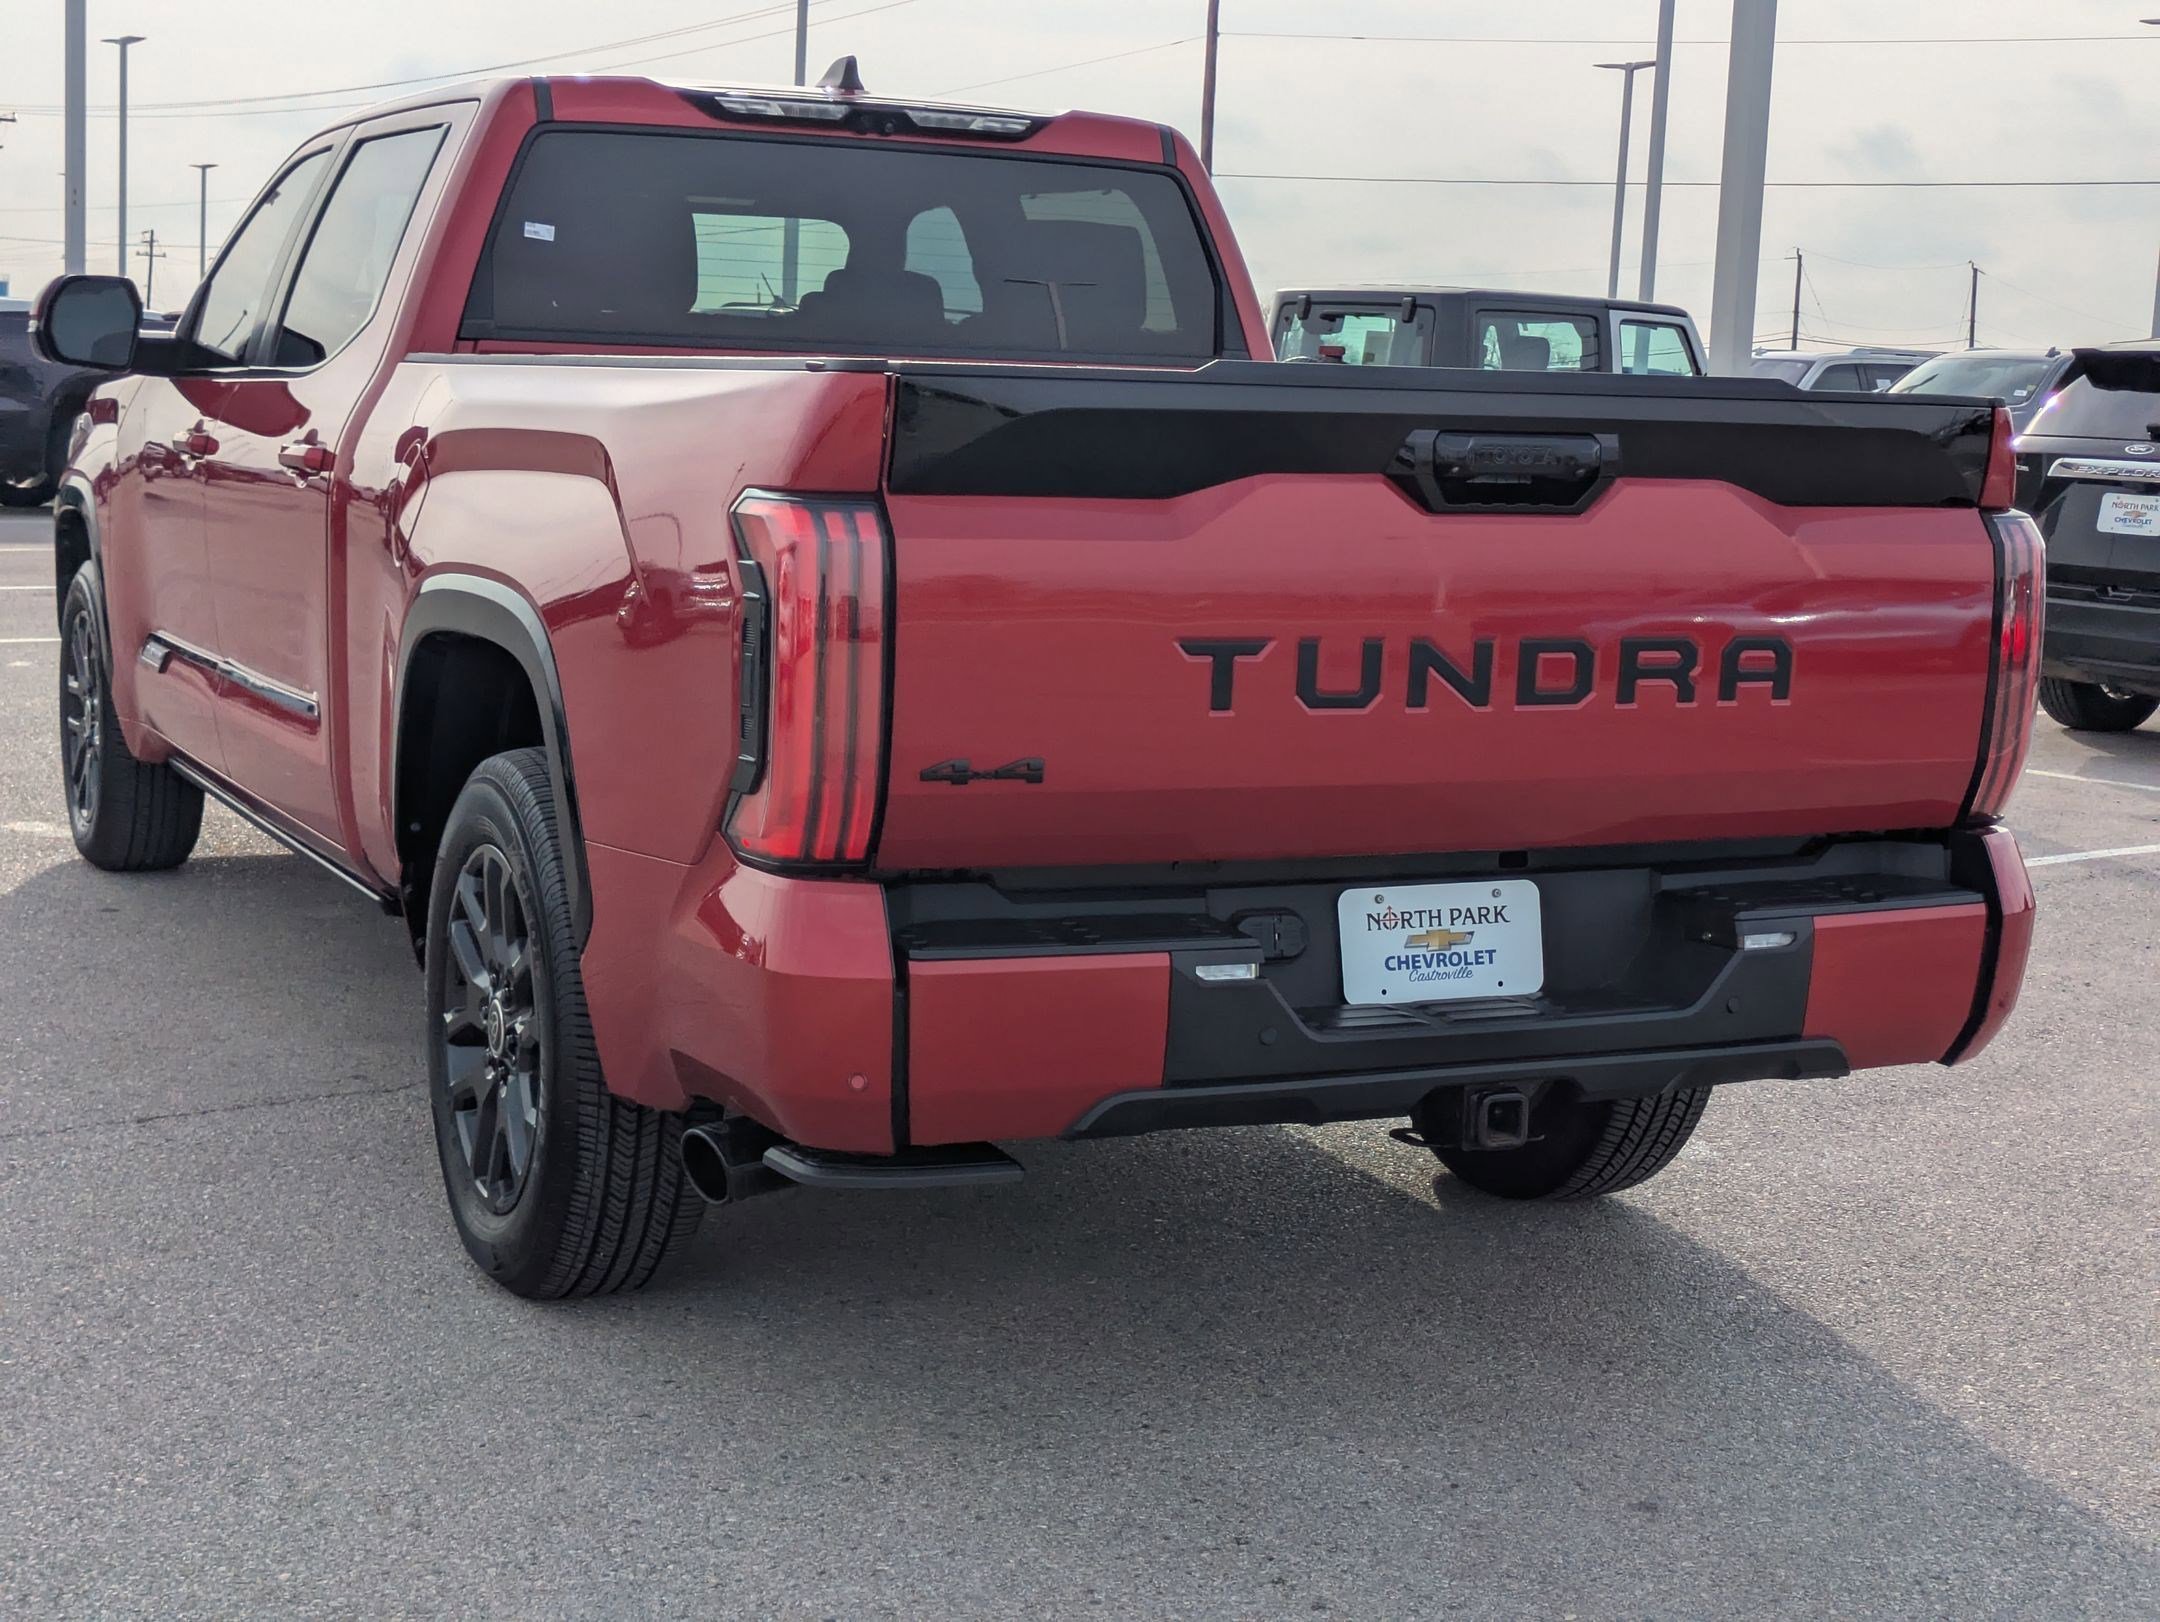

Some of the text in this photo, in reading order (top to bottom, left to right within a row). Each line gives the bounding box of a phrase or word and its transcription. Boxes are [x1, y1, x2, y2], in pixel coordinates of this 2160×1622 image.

[1481, 446, 1558, 465] TOYOTA
[2112, 501, 2160, 511] NORTH PARK
[2114, 517, 2153, 525] CHEVROLET
[1175, 635, 1794, 717] TUNDRA
[1366, 905, 1511, 931] NORTH PARK
[1384, 949, 1497, 971] CHEVROLET
[1408, 966, 1474, 982] Castroville
